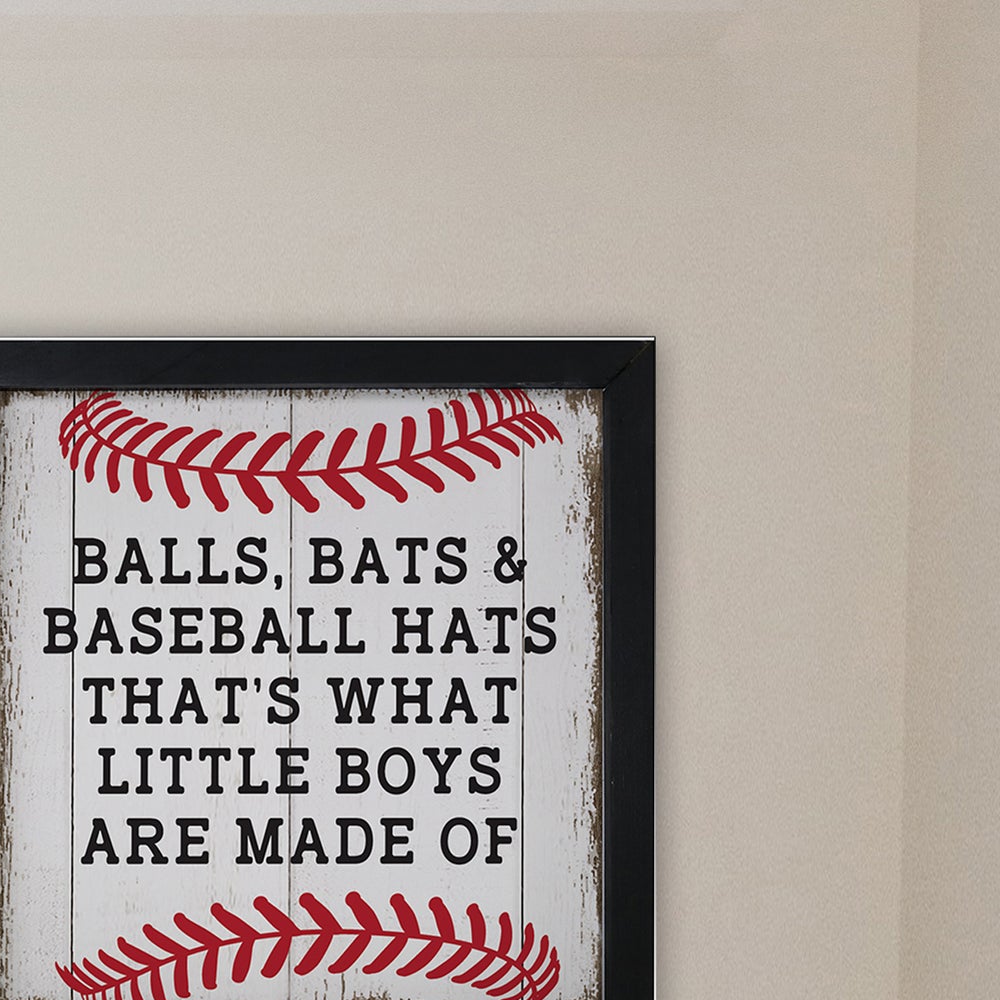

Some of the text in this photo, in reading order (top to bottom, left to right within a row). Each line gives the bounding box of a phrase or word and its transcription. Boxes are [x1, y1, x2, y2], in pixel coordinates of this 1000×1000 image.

[73, 537, 527, 590] BALLS, BATS &
[43, 607, 557, 654] BASEBALL HATS
[83, 677, 517, 725] THAT'S WHAT
[98, 747, 501, 795] LITTLE BOYS
[82, 817, 517, 865] ARE MADE OF
